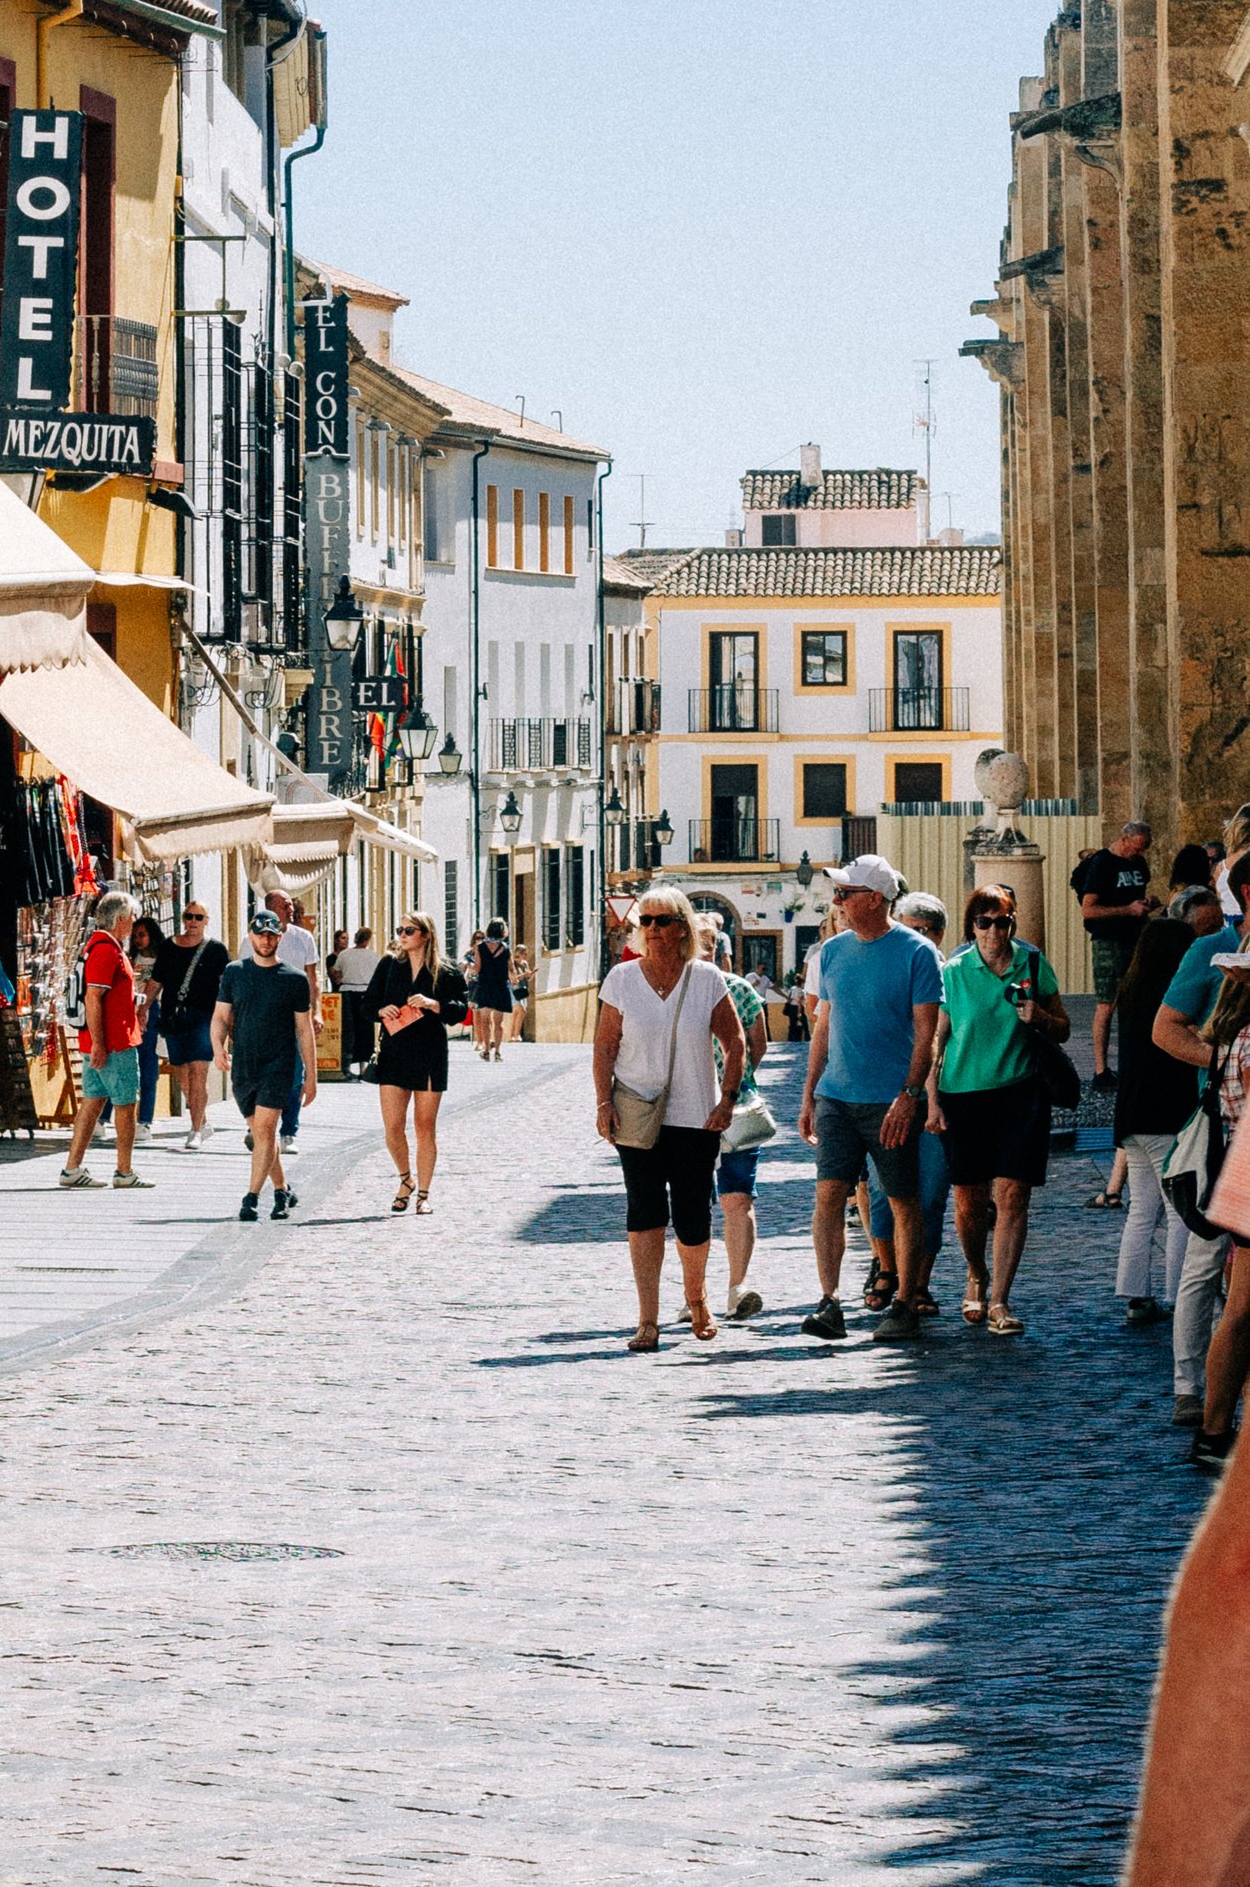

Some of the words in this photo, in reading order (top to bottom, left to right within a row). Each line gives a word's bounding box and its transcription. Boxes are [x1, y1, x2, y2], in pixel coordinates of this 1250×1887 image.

[16, 116, 71, 400] HOTEL
[315, 302, 336, 352] EL
[2, 418, 141, 466] MEZQUITA
[352, 681, 397, 707] EL
